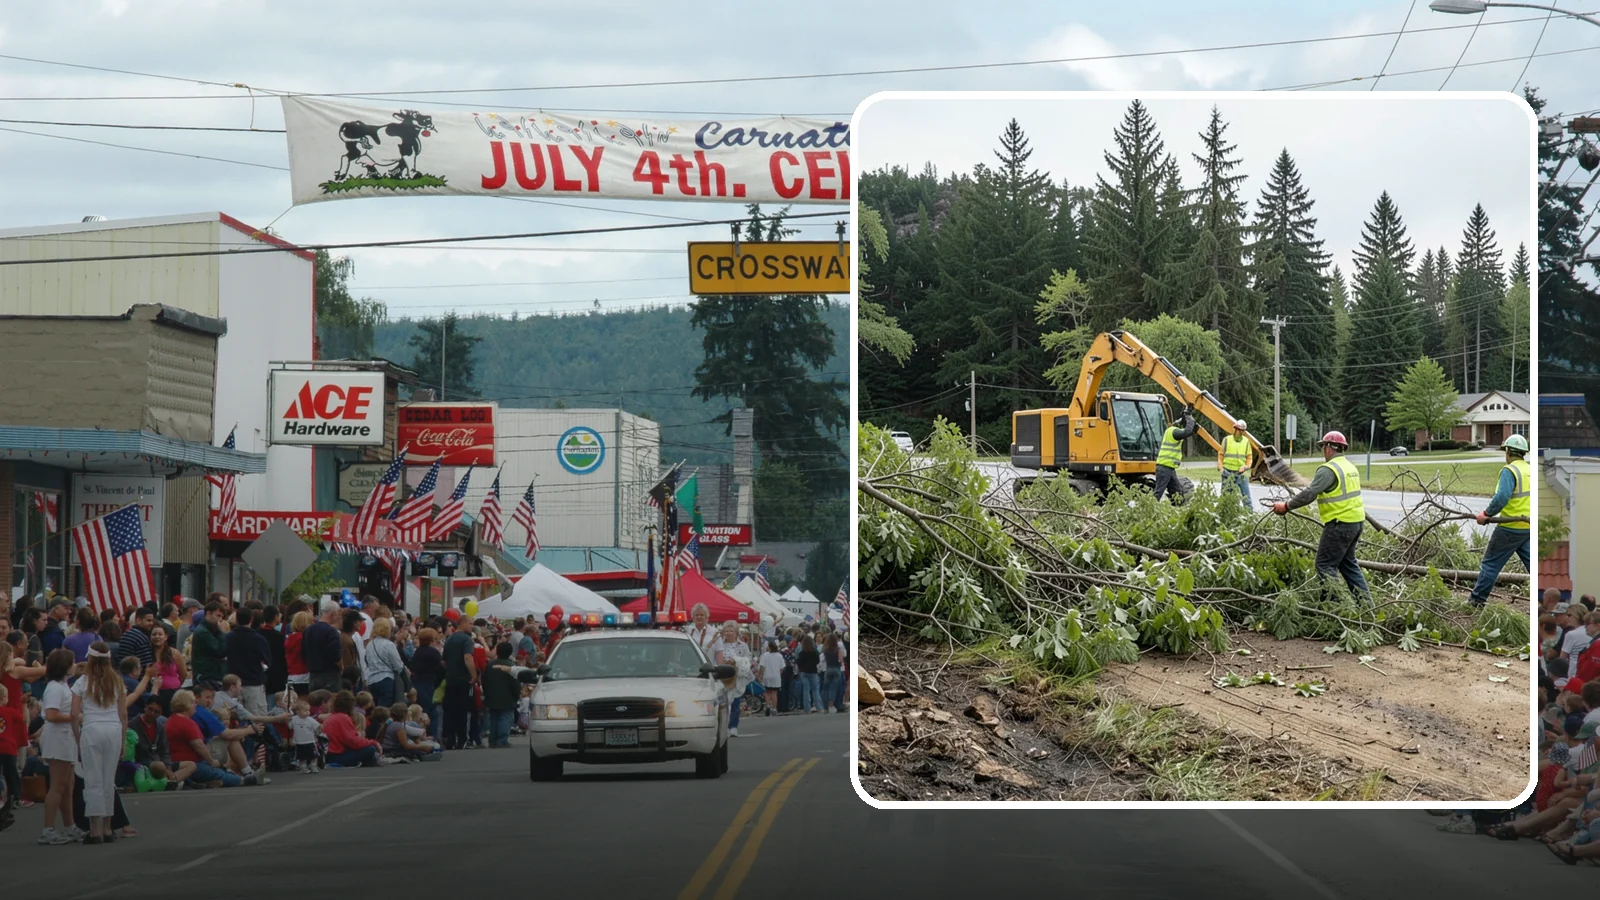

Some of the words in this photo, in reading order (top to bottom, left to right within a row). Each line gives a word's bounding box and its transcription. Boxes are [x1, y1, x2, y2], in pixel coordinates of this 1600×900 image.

[481, 141, 605, 192] JULY
[632, 150, 746, 198] 4th.
[697, 254, 850, 280] CROSSWA
[282, 380, 373, 420] ACE
[283, 421, 371, 436] Hardware
[416, 428, 476, 447] Coca-Cola
[95, 485, 124, 495] Vincent
[126, 485, 136, 495] de
[138, 485, 155, 495] Paul
[688, 526, 741, 535] CRNATION
[699, 535, 730, 543] GLASS
